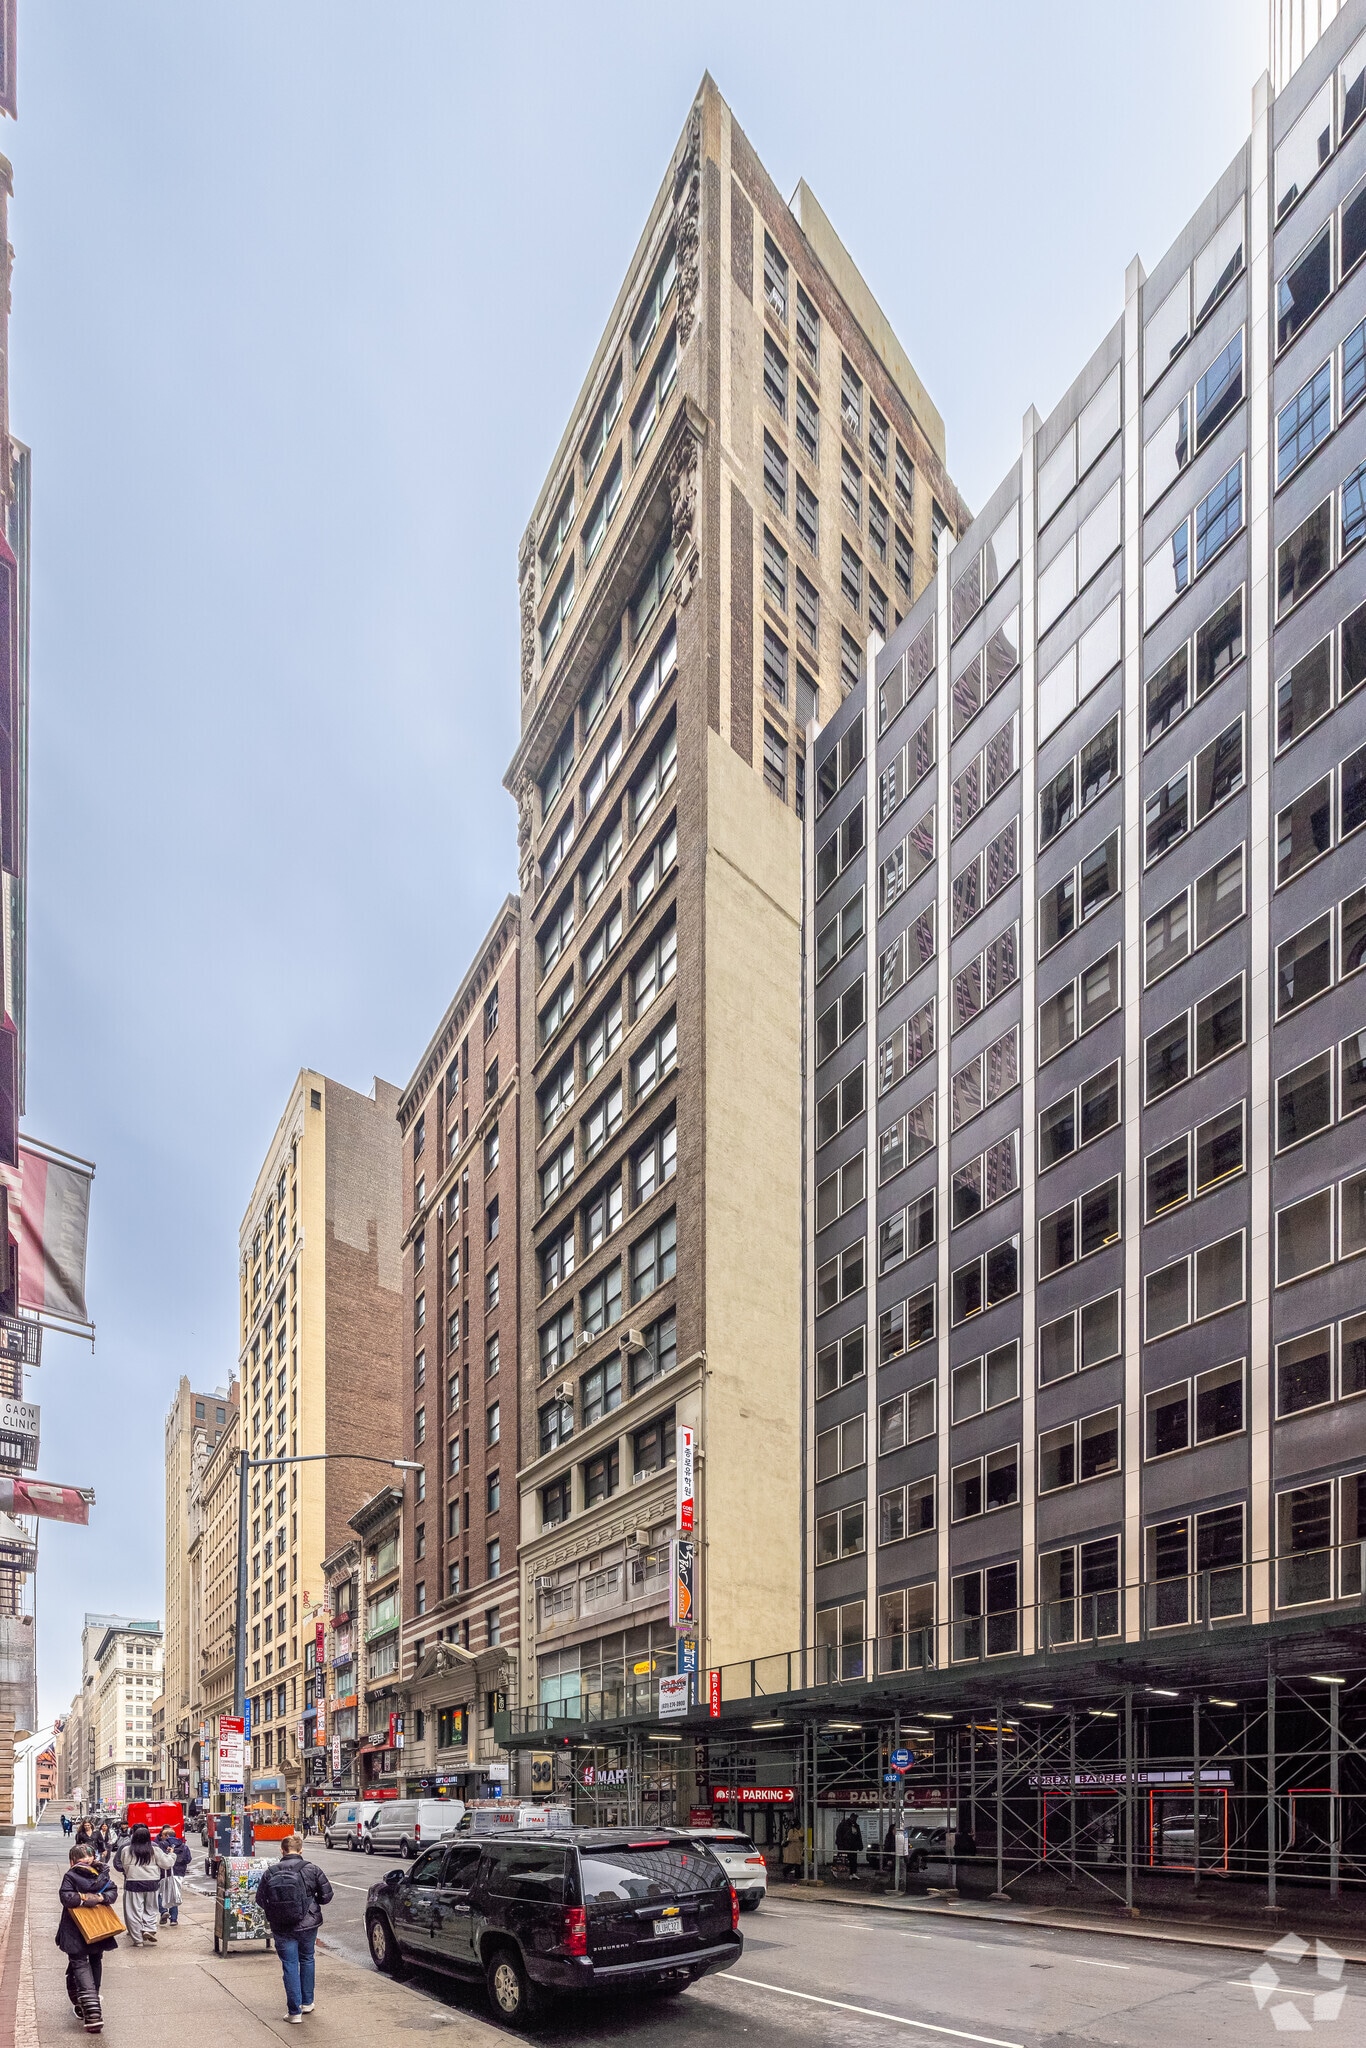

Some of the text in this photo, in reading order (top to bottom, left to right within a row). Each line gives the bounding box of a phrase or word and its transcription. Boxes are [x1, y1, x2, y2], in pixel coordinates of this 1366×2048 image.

[5, 1403, 35, 1418] GAON
[3, 1415, 37, 1432] CLINIC
[532, 1761, 551, 1783] 38
[743, 1789, 784, 1800] PARKING
[593, 1943, 630, 1952] SUBURBAN
